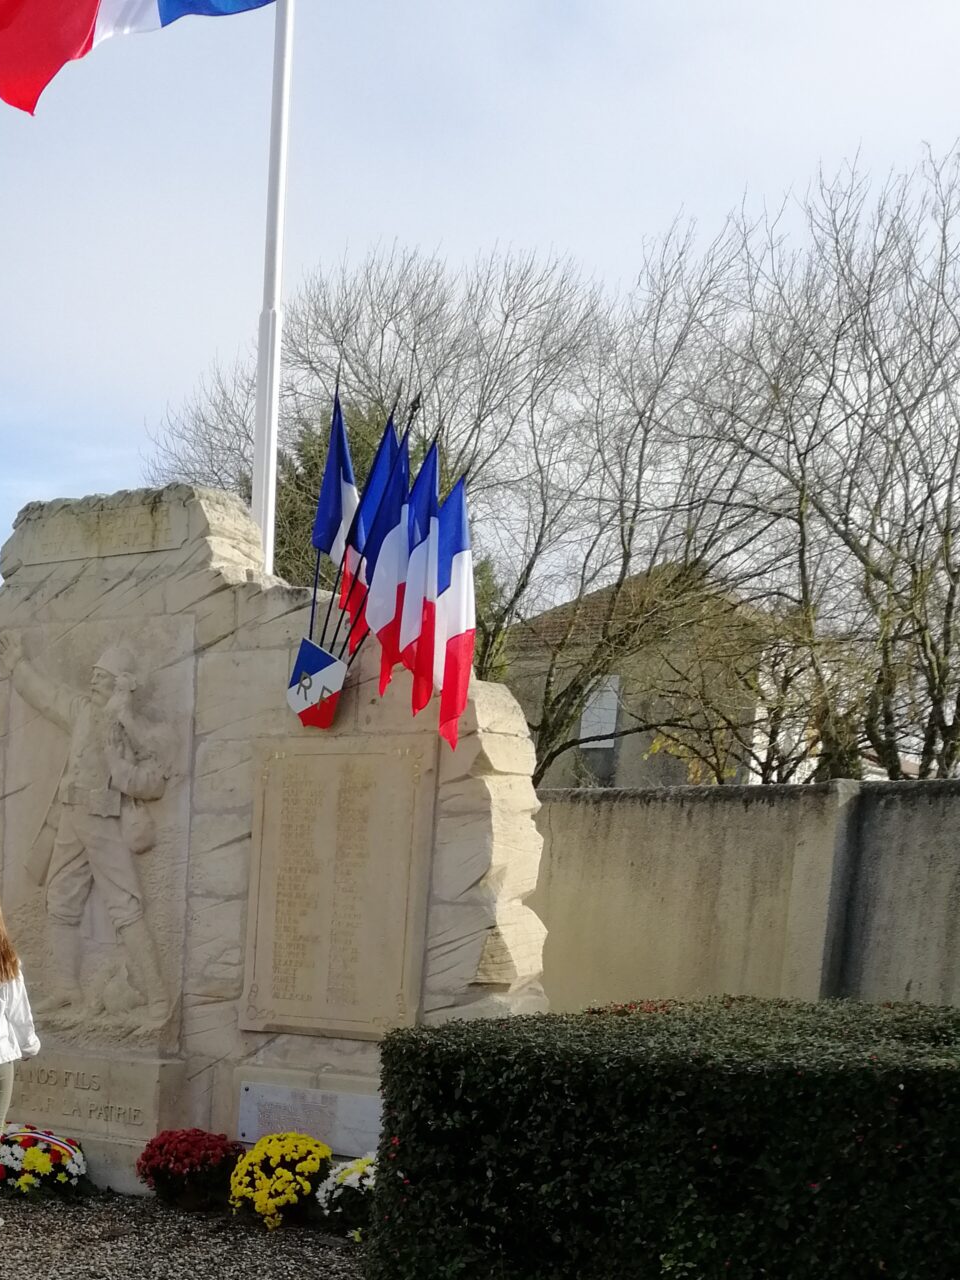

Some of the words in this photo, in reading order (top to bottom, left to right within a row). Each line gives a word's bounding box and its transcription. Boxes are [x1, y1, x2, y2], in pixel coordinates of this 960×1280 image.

[14, 1064, 24, 1082] A
[28, 1066, 58, 1086] NOS
[63, 1069, 101, 1092] FILS
[62, 1098, 82, 1118] LA
[87, 1101, 145, 1126] PATRIE
